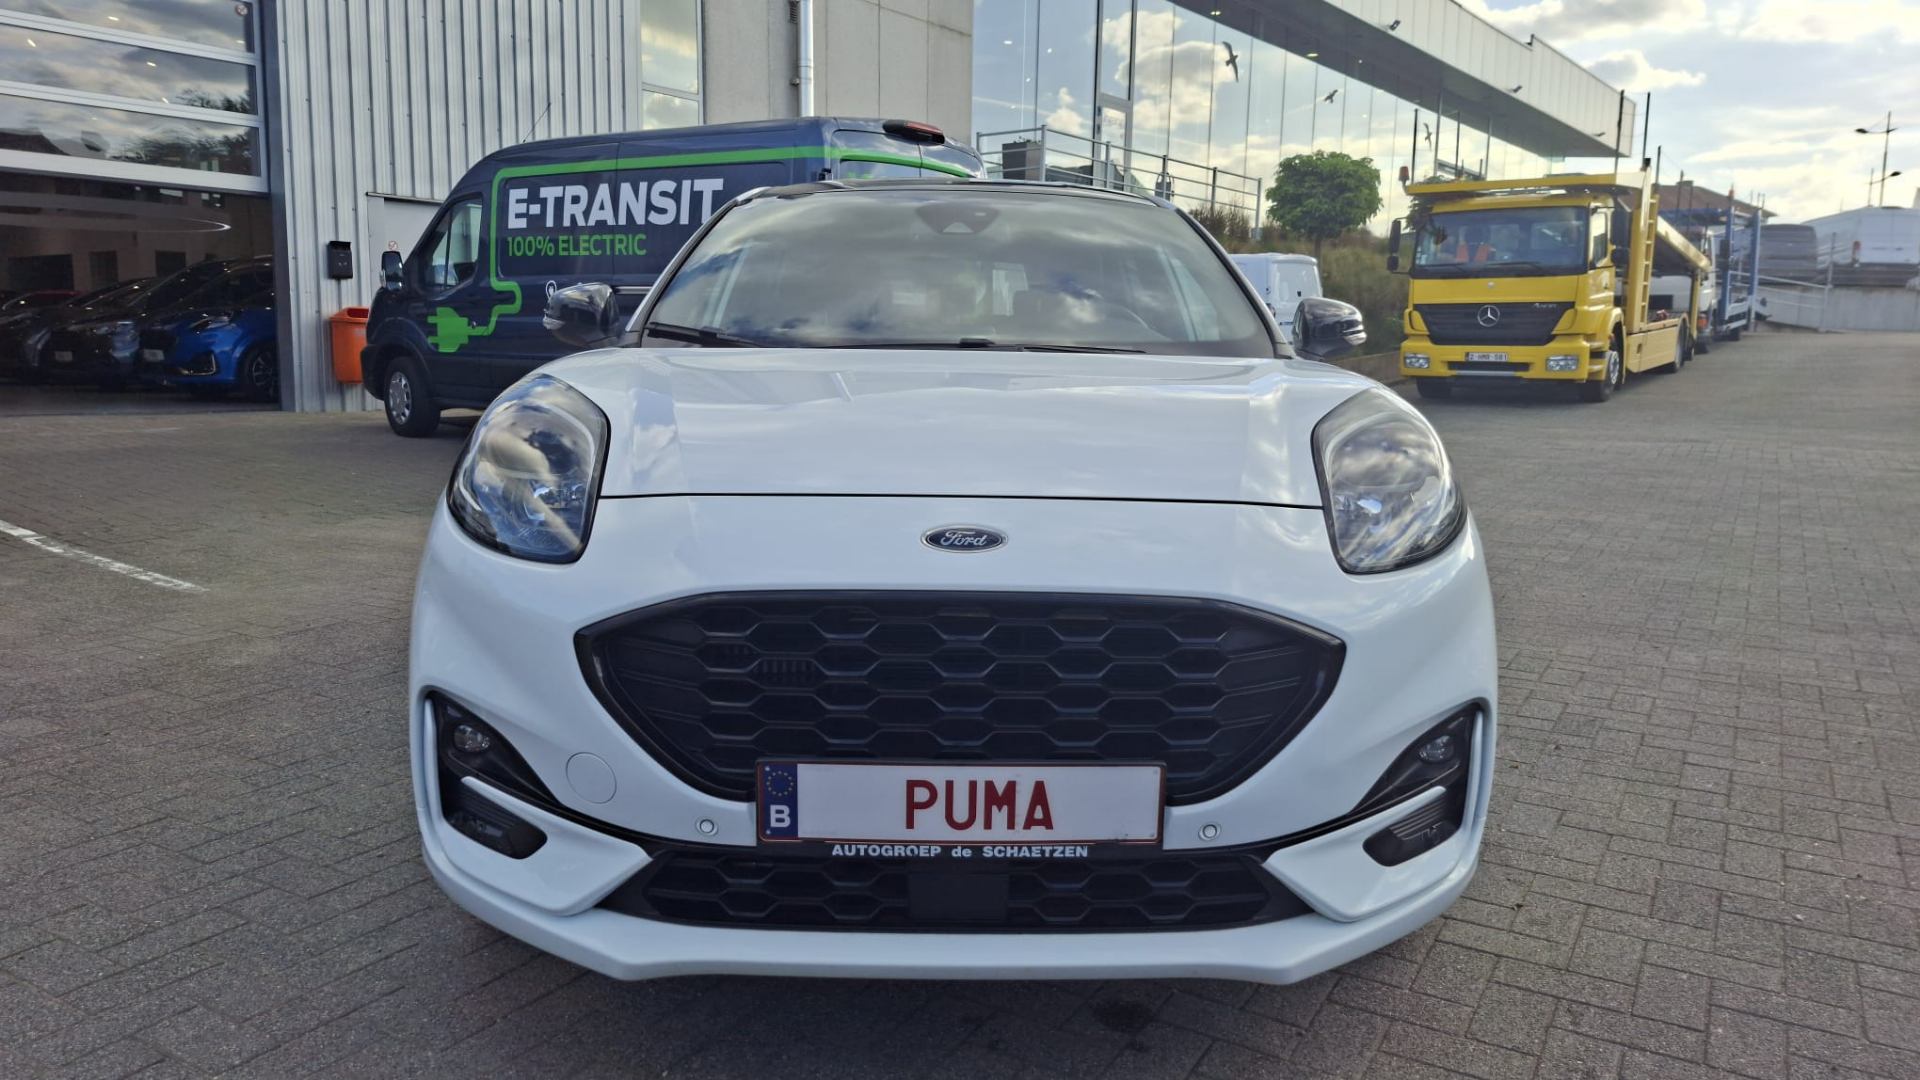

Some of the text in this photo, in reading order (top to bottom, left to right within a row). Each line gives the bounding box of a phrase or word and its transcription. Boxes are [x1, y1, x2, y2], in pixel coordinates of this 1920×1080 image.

[507, 178, 724, 230] E-TRANSIT
[507, 233, 647, 257] 100% ELECTRIC
[940, 530, 988, 546] Ford
[769, 805, 791, 828] B
[905, 779, 1054, 831] PUMA
[831, 844, 1089, 858] AUTOGROEP de SCHAETZEN
